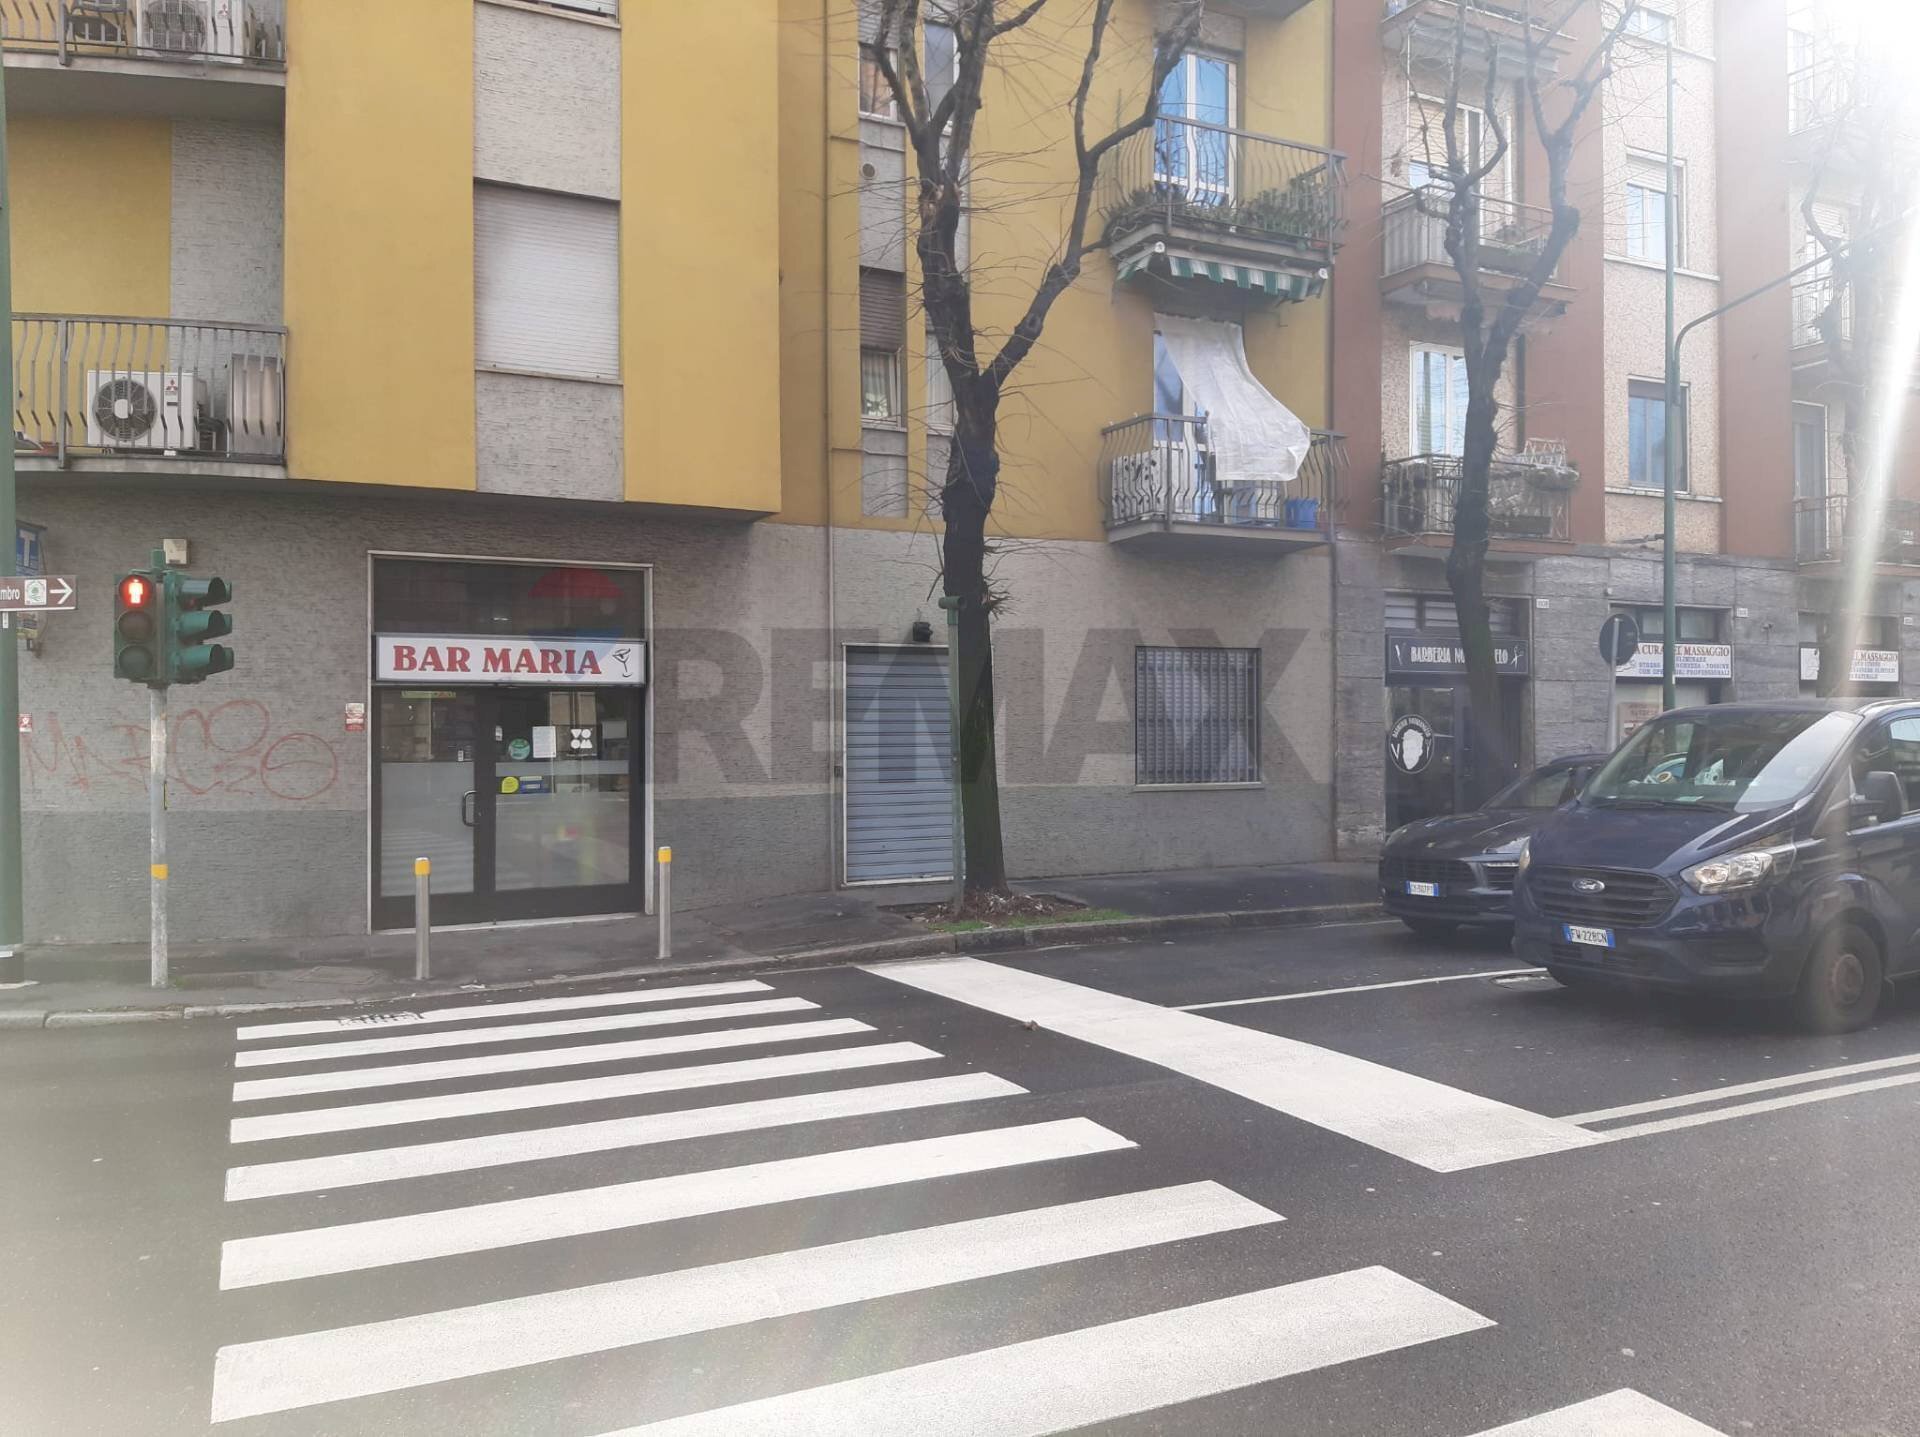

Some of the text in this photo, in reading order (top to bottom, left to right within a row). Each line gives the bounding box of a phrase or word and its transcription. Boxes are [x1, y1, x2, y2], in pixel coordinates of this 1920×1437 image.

[392, 645, 602, 675] BAR MARIA
[1410, 646, 1451, 663] BARBERIA
[1684, 647, 1730, 657] MASSAGGIO
